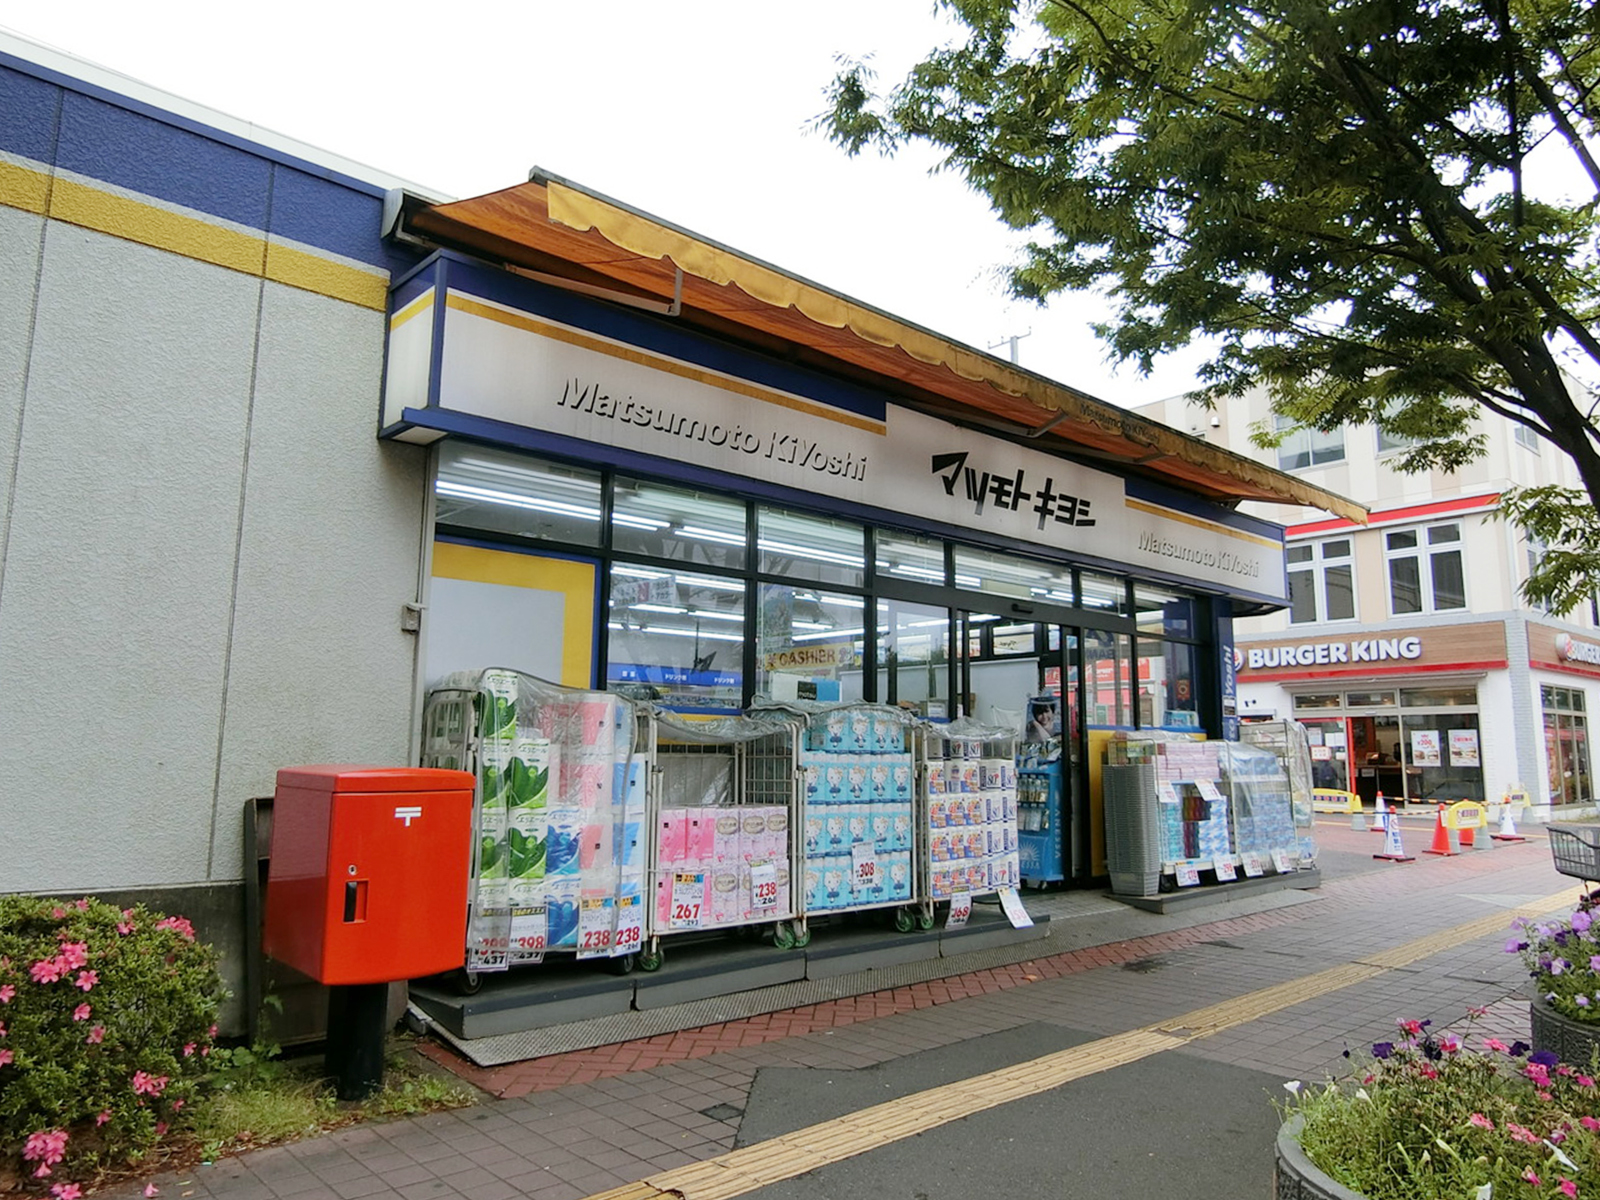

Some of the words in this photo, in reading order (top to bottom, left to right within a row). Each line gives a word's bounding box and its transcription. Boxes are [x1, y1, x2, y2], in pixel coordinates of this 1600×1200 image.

[557, 377, 760, 455] Matsumoto
[932, 451, 1096, 531] マツモトキヨシ
[1137, 529, 1216, 568] Matsumoto
[779, 649, 837, 666] CASHIER
[1247, 641, 1349, 669] BURGER
[1351, 636, 1422, 662] KING
[860, 862, 875, 878] 308
[758, 881, 777, 898] 238
[675, 904, 700, 919] 267
[584, 929, 611, 949] 238
[615, 925, 641, 946] 238
[483, 955, 505, 965] 437
